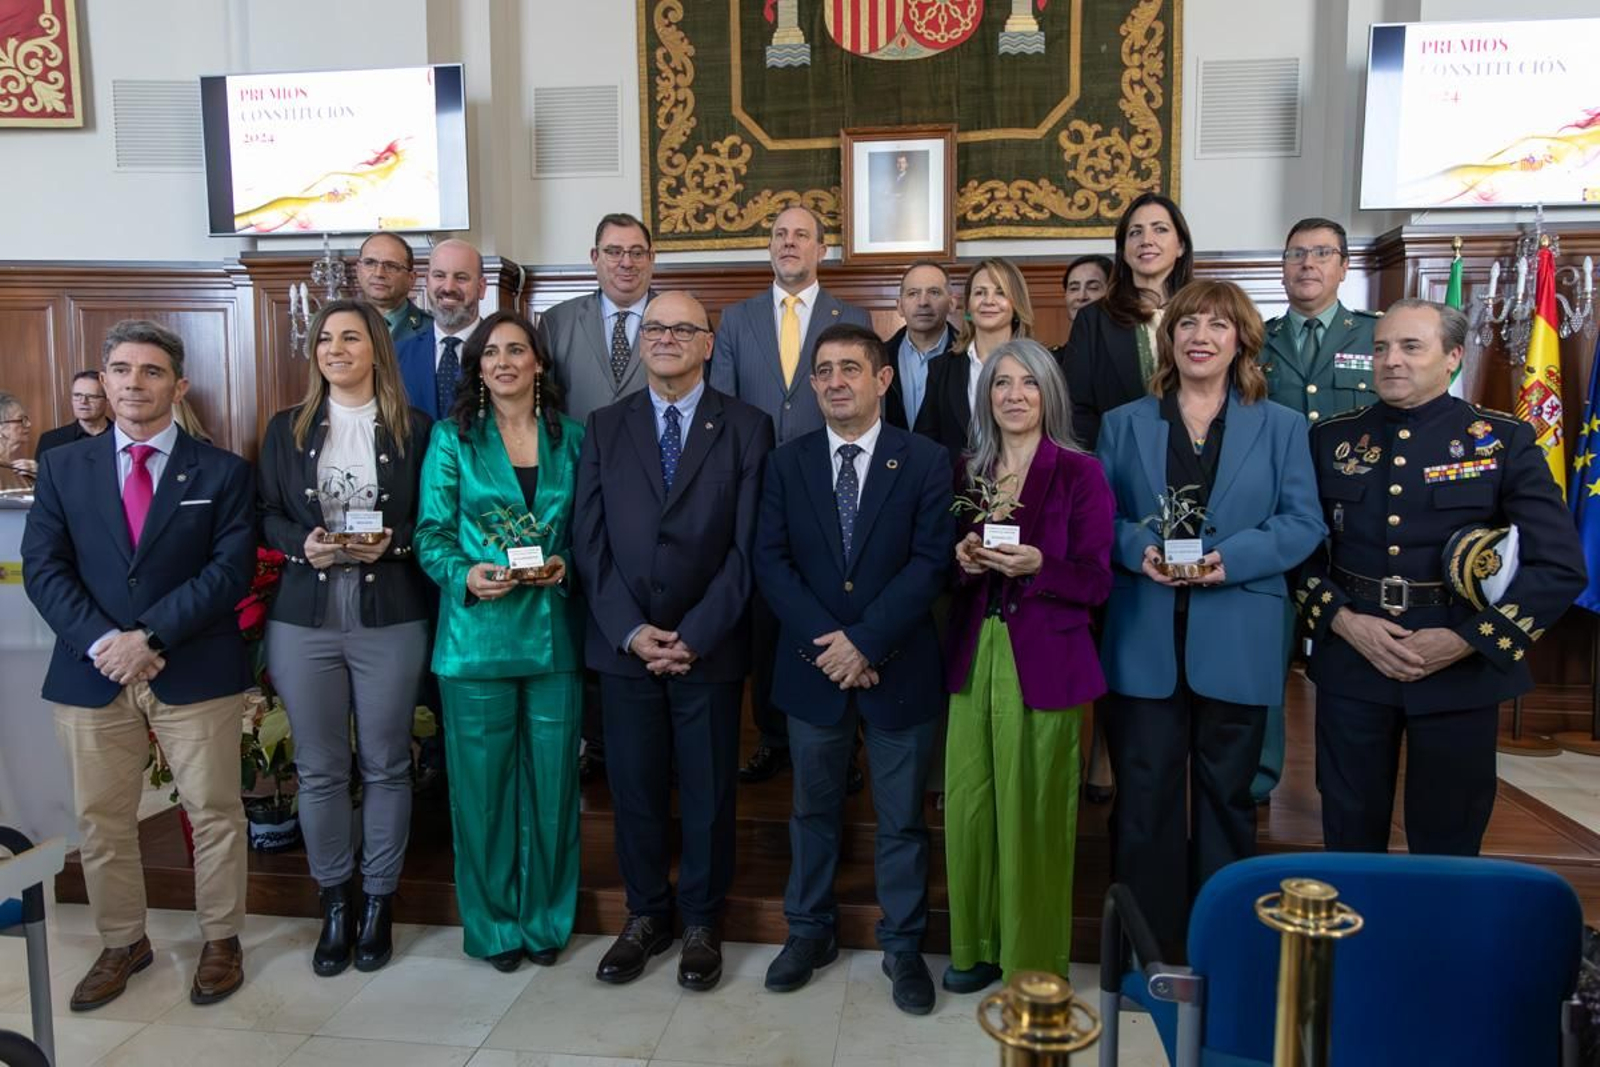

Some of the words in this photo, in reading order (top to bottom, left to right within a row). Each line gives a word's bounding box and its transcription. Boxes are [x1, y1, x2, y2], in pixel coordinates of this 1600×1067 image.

[1421, 38, 1509, 54] PREMIOS
[240, 86, 309, 102] PREMIOS
[243, 132, 276, 145] 2024
